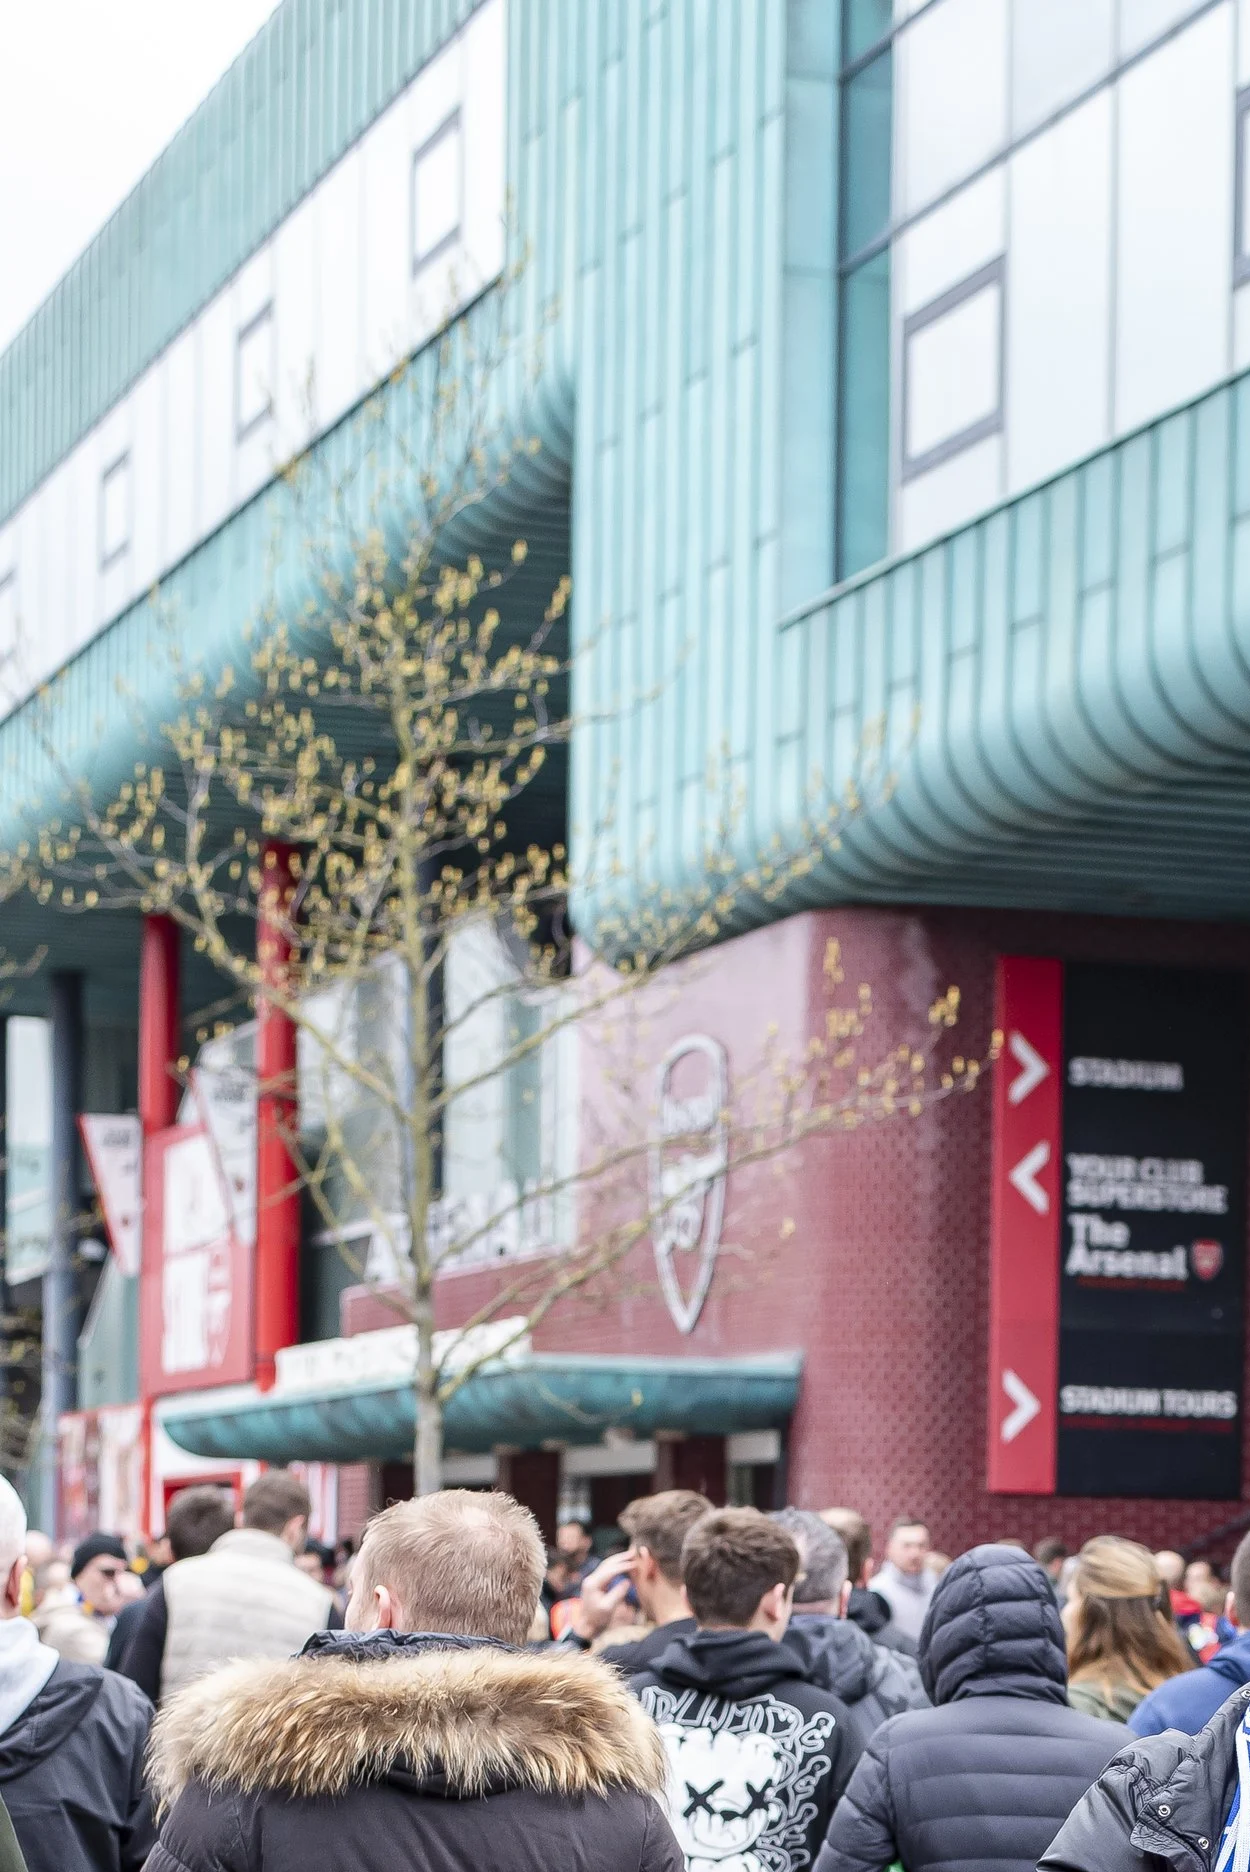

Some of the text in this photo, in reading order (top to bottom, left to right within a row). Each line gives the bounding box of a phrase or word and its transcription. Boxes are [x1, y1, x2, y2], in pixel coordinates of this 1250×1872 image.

[1068, 1056, 1184, 1091] STADIUM
[1067, 1213, 1131, 1249] The
[1065, 1245, 1189, 1281] Arsenal
[1060, 1385, 1237, 1419] STADIUM TOURS
